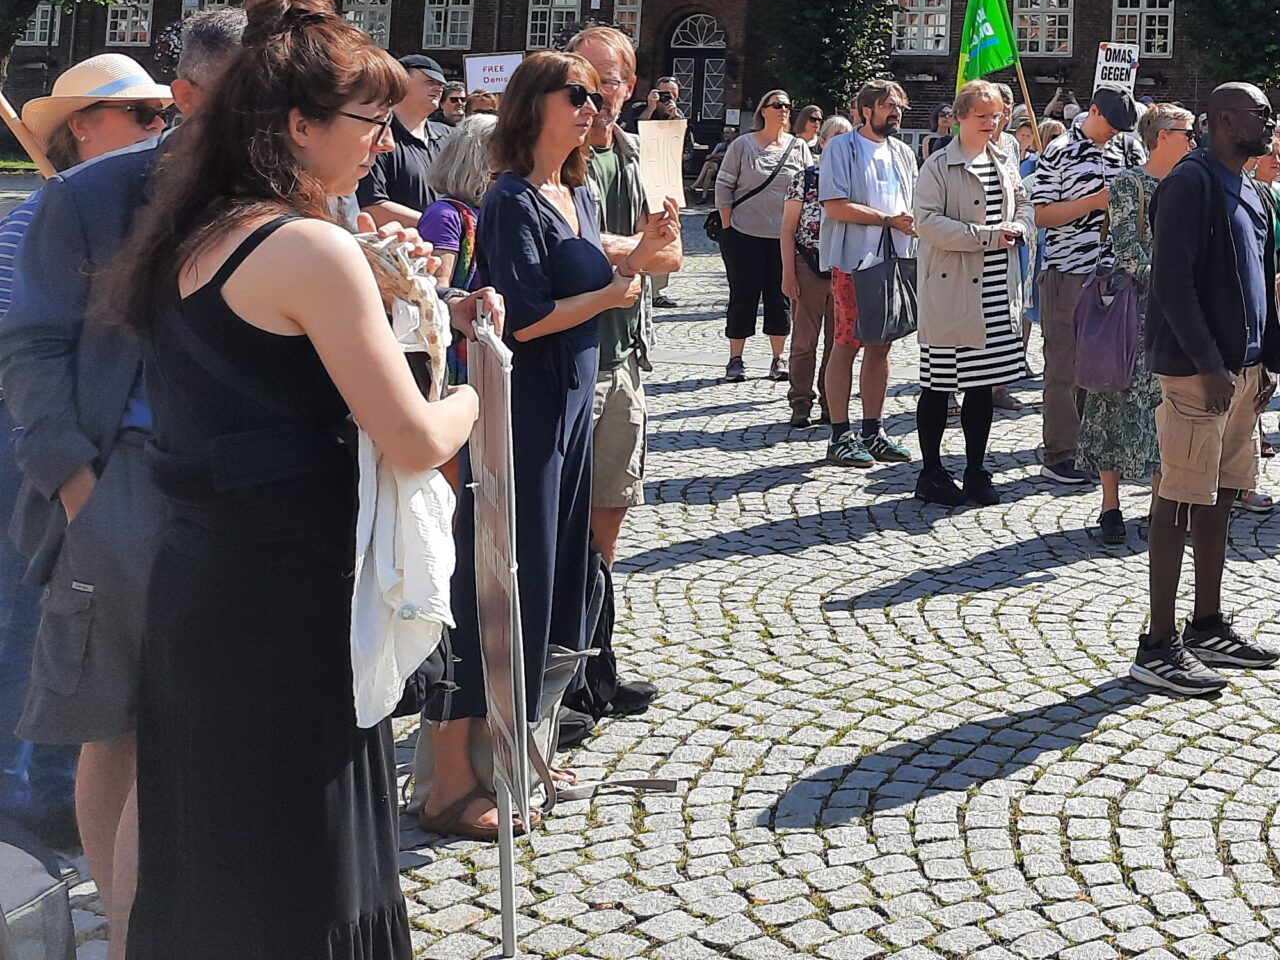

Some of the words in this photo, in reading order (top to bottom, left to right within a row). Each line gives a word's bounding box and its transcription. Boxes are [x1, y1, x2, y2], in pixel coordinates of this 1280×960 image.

[1104, 48, 1133, 64] OMAS
[482, 64, 505, 73] FREE
[1101, 66, 1131, 81] GEGEN
